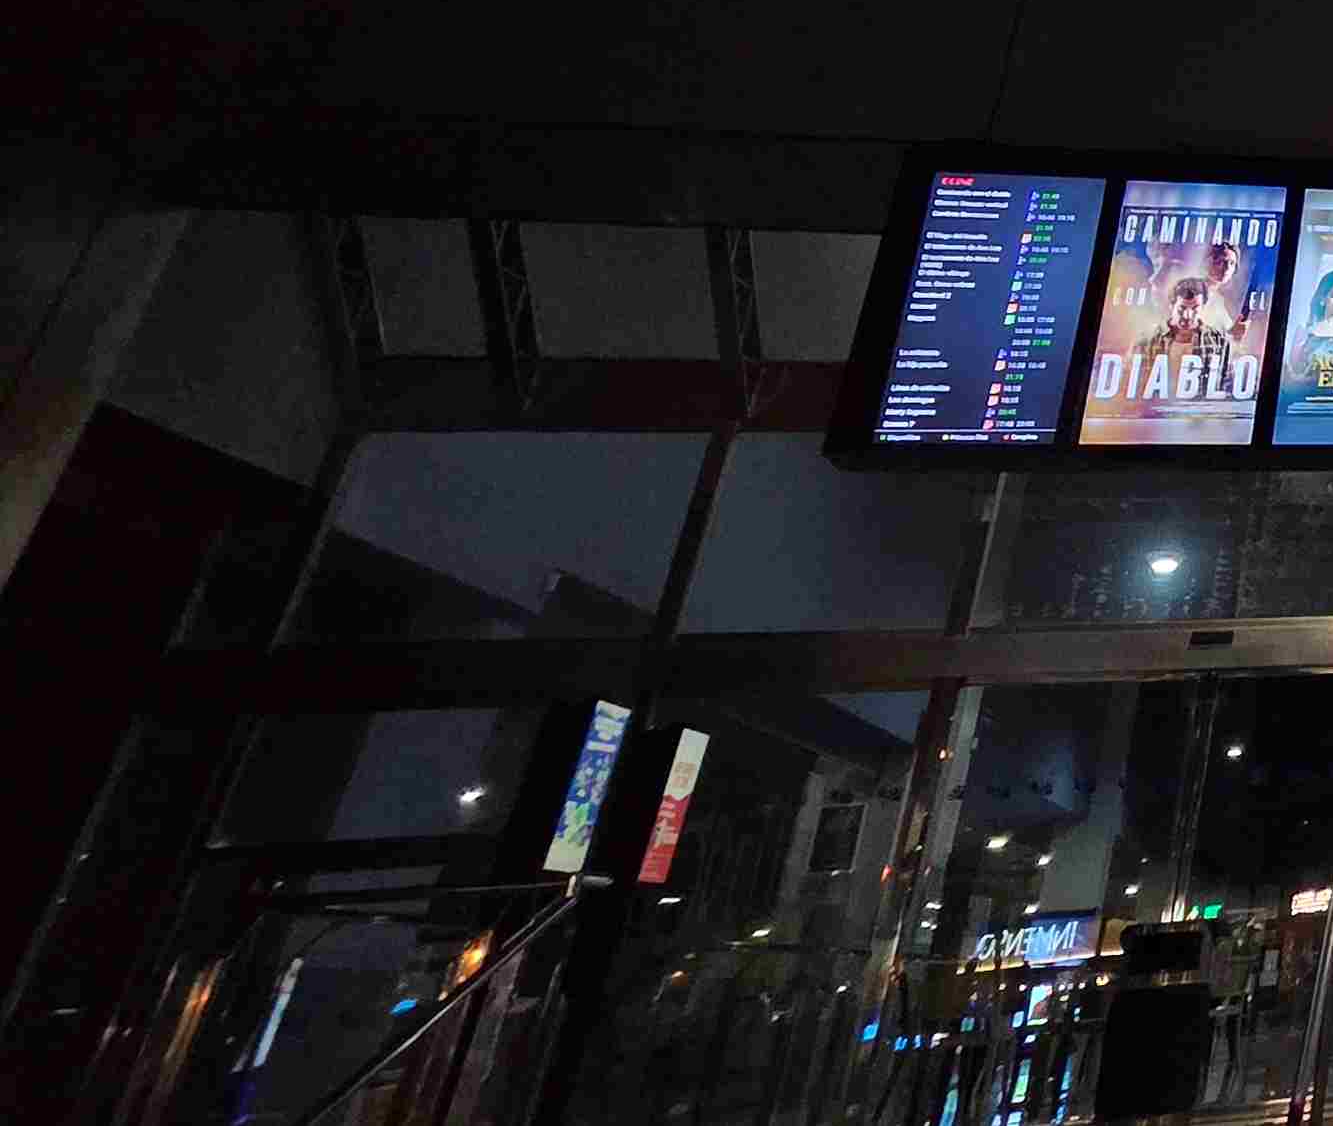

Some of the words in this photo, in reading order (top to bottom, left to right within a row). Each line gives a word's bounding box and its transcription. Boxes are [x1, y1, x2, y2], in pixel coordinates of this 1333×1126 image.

[1124, 214, 1278, 247] CAMINANDO
[1113, 287, 1147, 307] CON
[1249, 290, 1266, 310] EL
[1095, 353, 1258, 401] DIABLO
